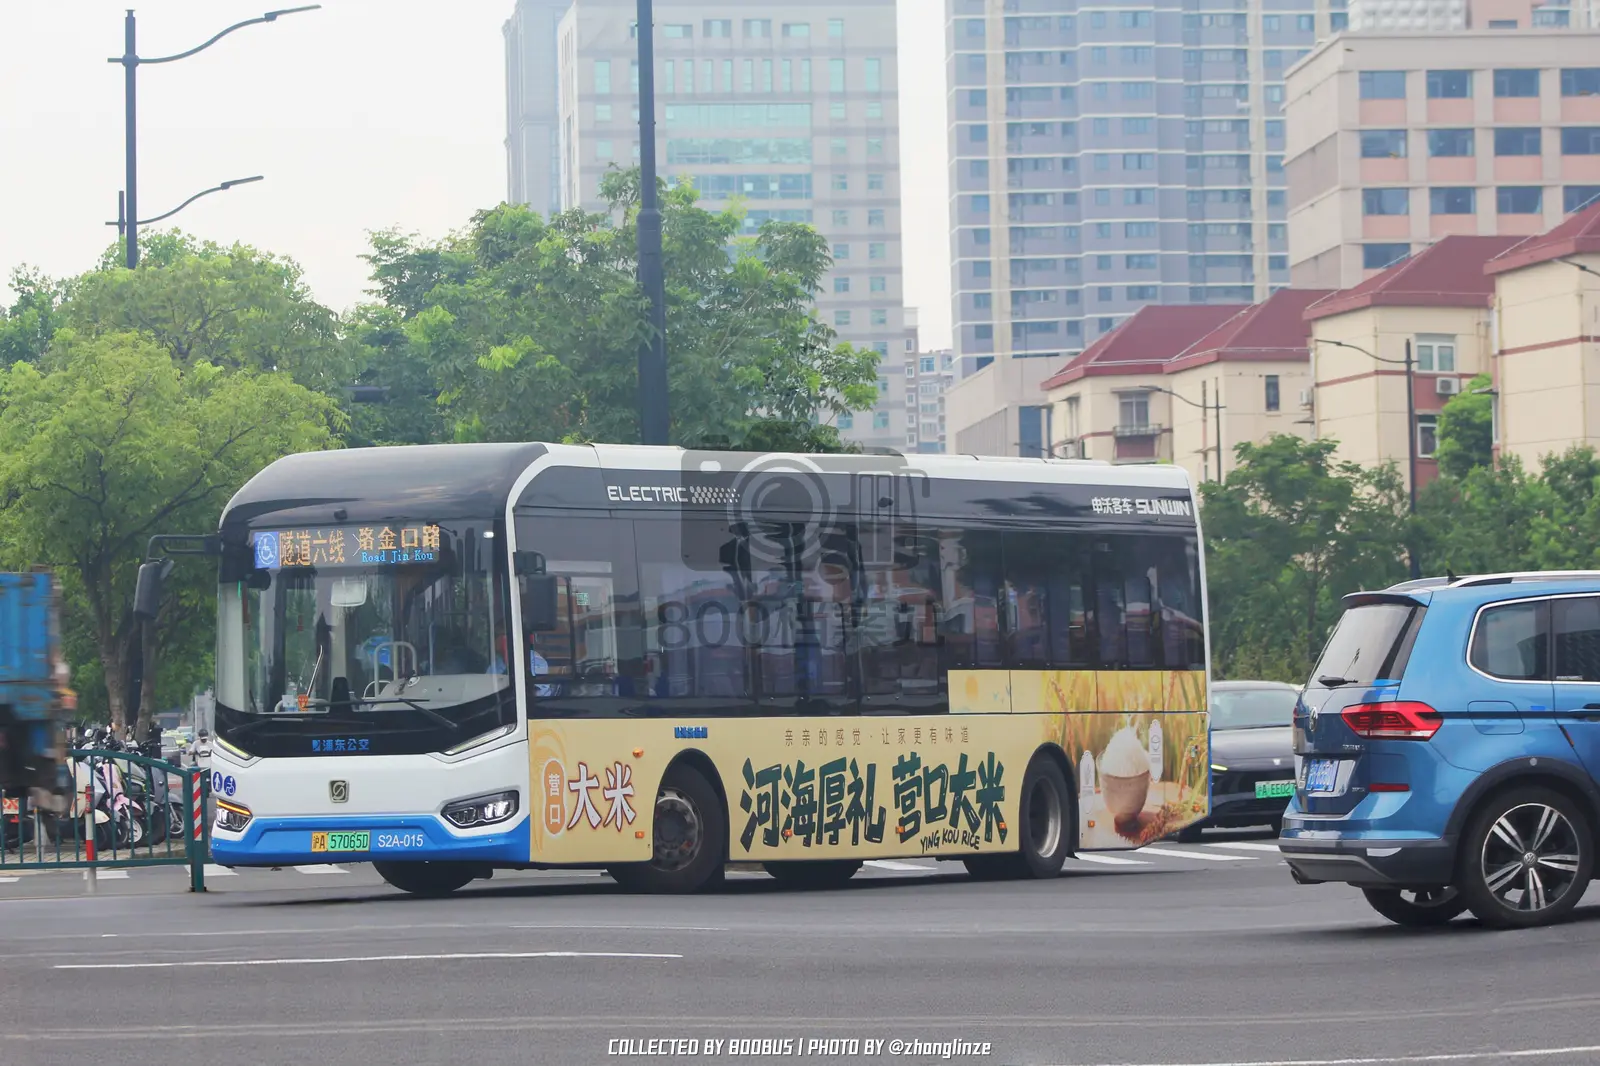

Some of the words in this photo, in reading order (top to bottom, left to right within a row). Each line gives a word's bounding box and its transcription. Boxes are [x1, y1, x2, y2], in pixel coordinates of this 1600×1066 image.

[606, 485, 688, 502] ELECTRIC
[1091, 497, 1134, 515] 申沃客车
[1135, 498, 1191, 516] SUNWIN
[279, 530, 346, 567] 隧道六线
[361, 551, 387, 564] Road
[391, 550, 410, 564] Jin
[414, 549, 434, 561] Kou
[322, 738, 370, 752] 浦东公交
[548, 773, 562, 825] 营口
[566, 760, 638, 833] 大米
[739, 756, 887, 853] 河海厚礼
[892, 751, 1008, 845] 营口大米
[377, 834, 424, 848] S2A-015
[920, 829, 940, 855] YING
[942, 827, 959, 845] KOU
[961, 830, 980, 851] RICE
